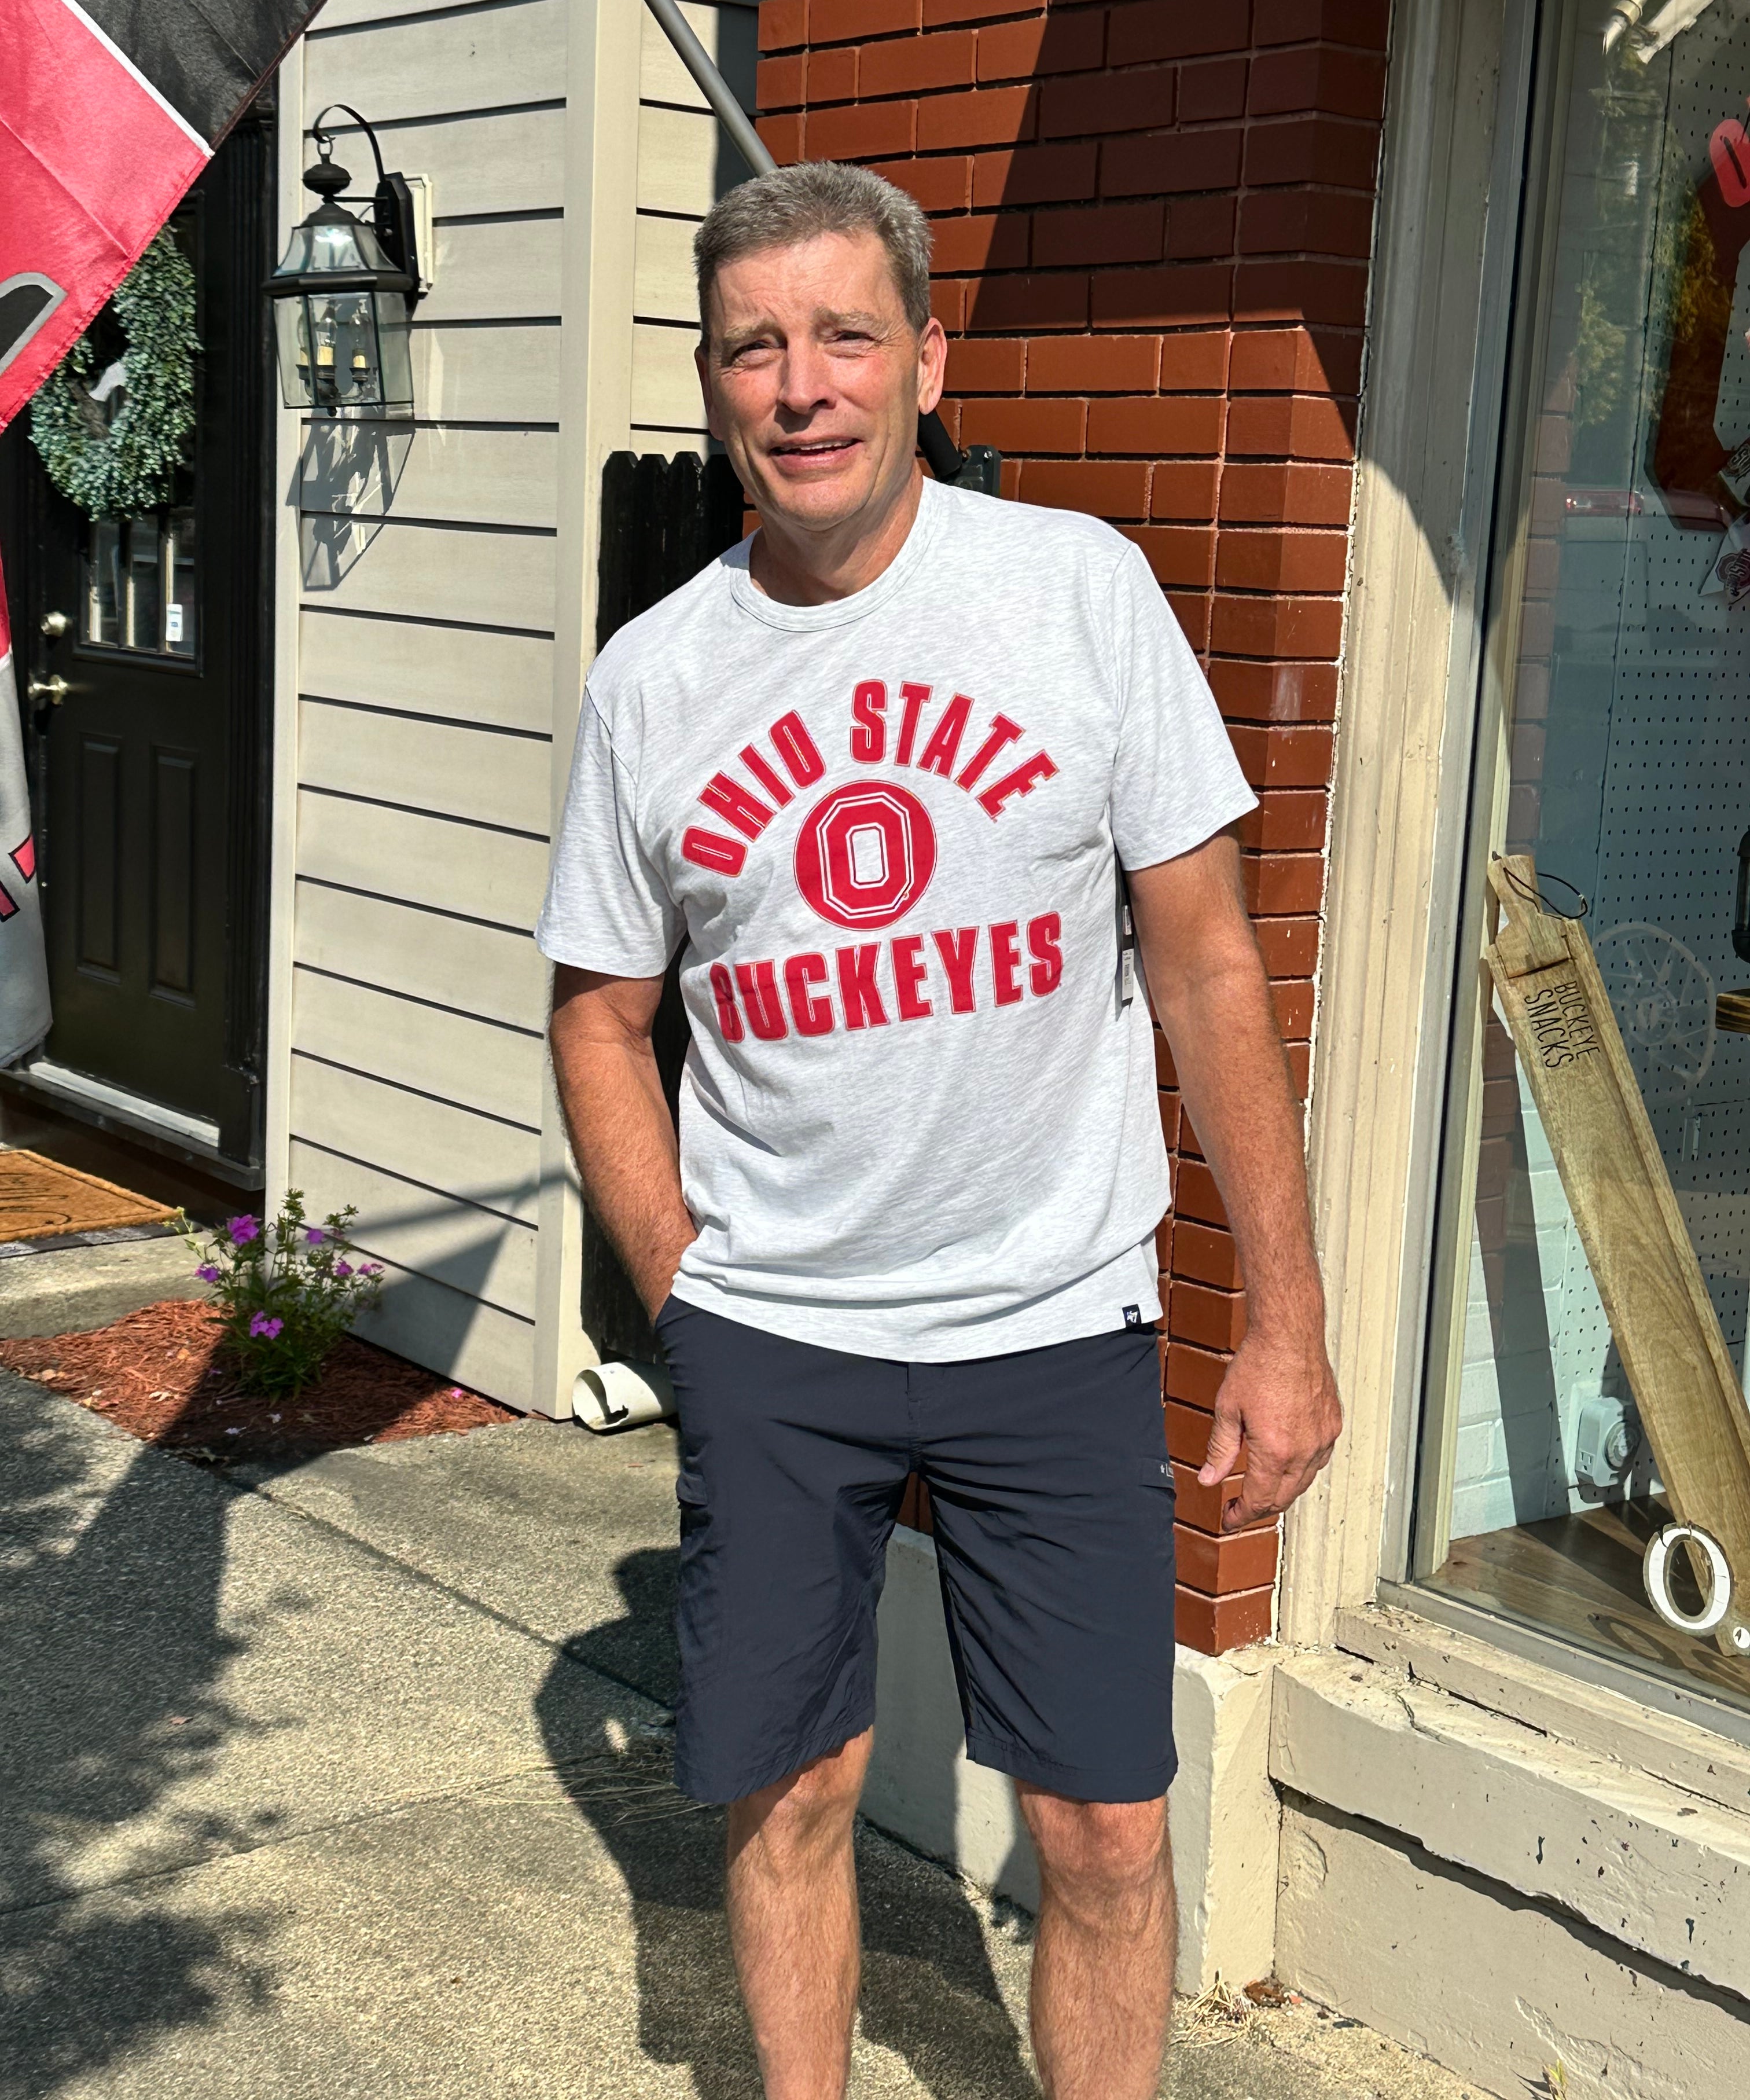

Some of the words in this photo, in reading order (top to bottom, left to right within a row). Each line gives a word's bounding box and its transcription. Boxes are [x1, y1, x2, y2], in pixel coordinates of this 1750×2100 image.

[681, 709, 826, 878] OHIO
[850, 678, 1060, 822] STATE
[816, 791, 914, 919] O
[709, 911, 1064, 1044] BUCKEYES
[1524, 989, 1574, 1068] SNACKS
[1554, 980, 1600, 1060] BUCKEYE
